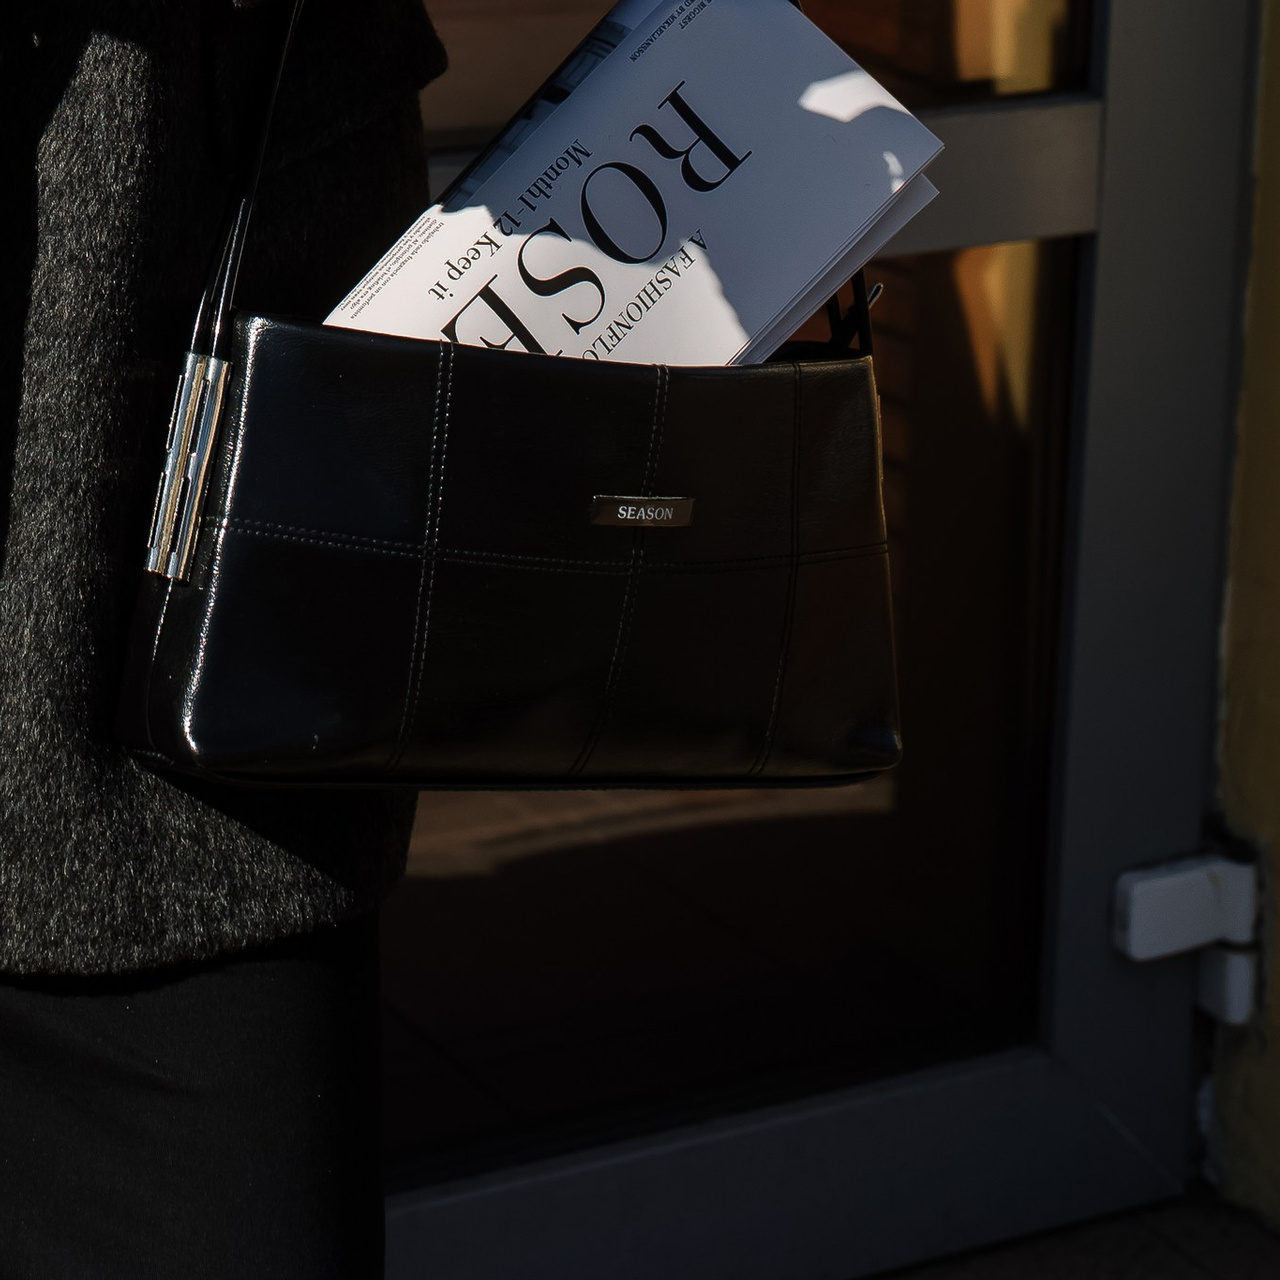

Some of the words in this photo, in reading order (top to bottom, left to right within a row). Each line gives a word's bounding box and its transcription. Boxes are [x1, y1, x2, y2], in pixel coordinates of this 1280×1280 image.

[675, 4, 685, 16] BY
[678, 0, 707, 29] BIGGEST
[685, 228, 714, 256] A
[443, 230, 503, 280] Keep
[427, 280, 453, 300] it
[617, 505, 674, 521] SEASON
